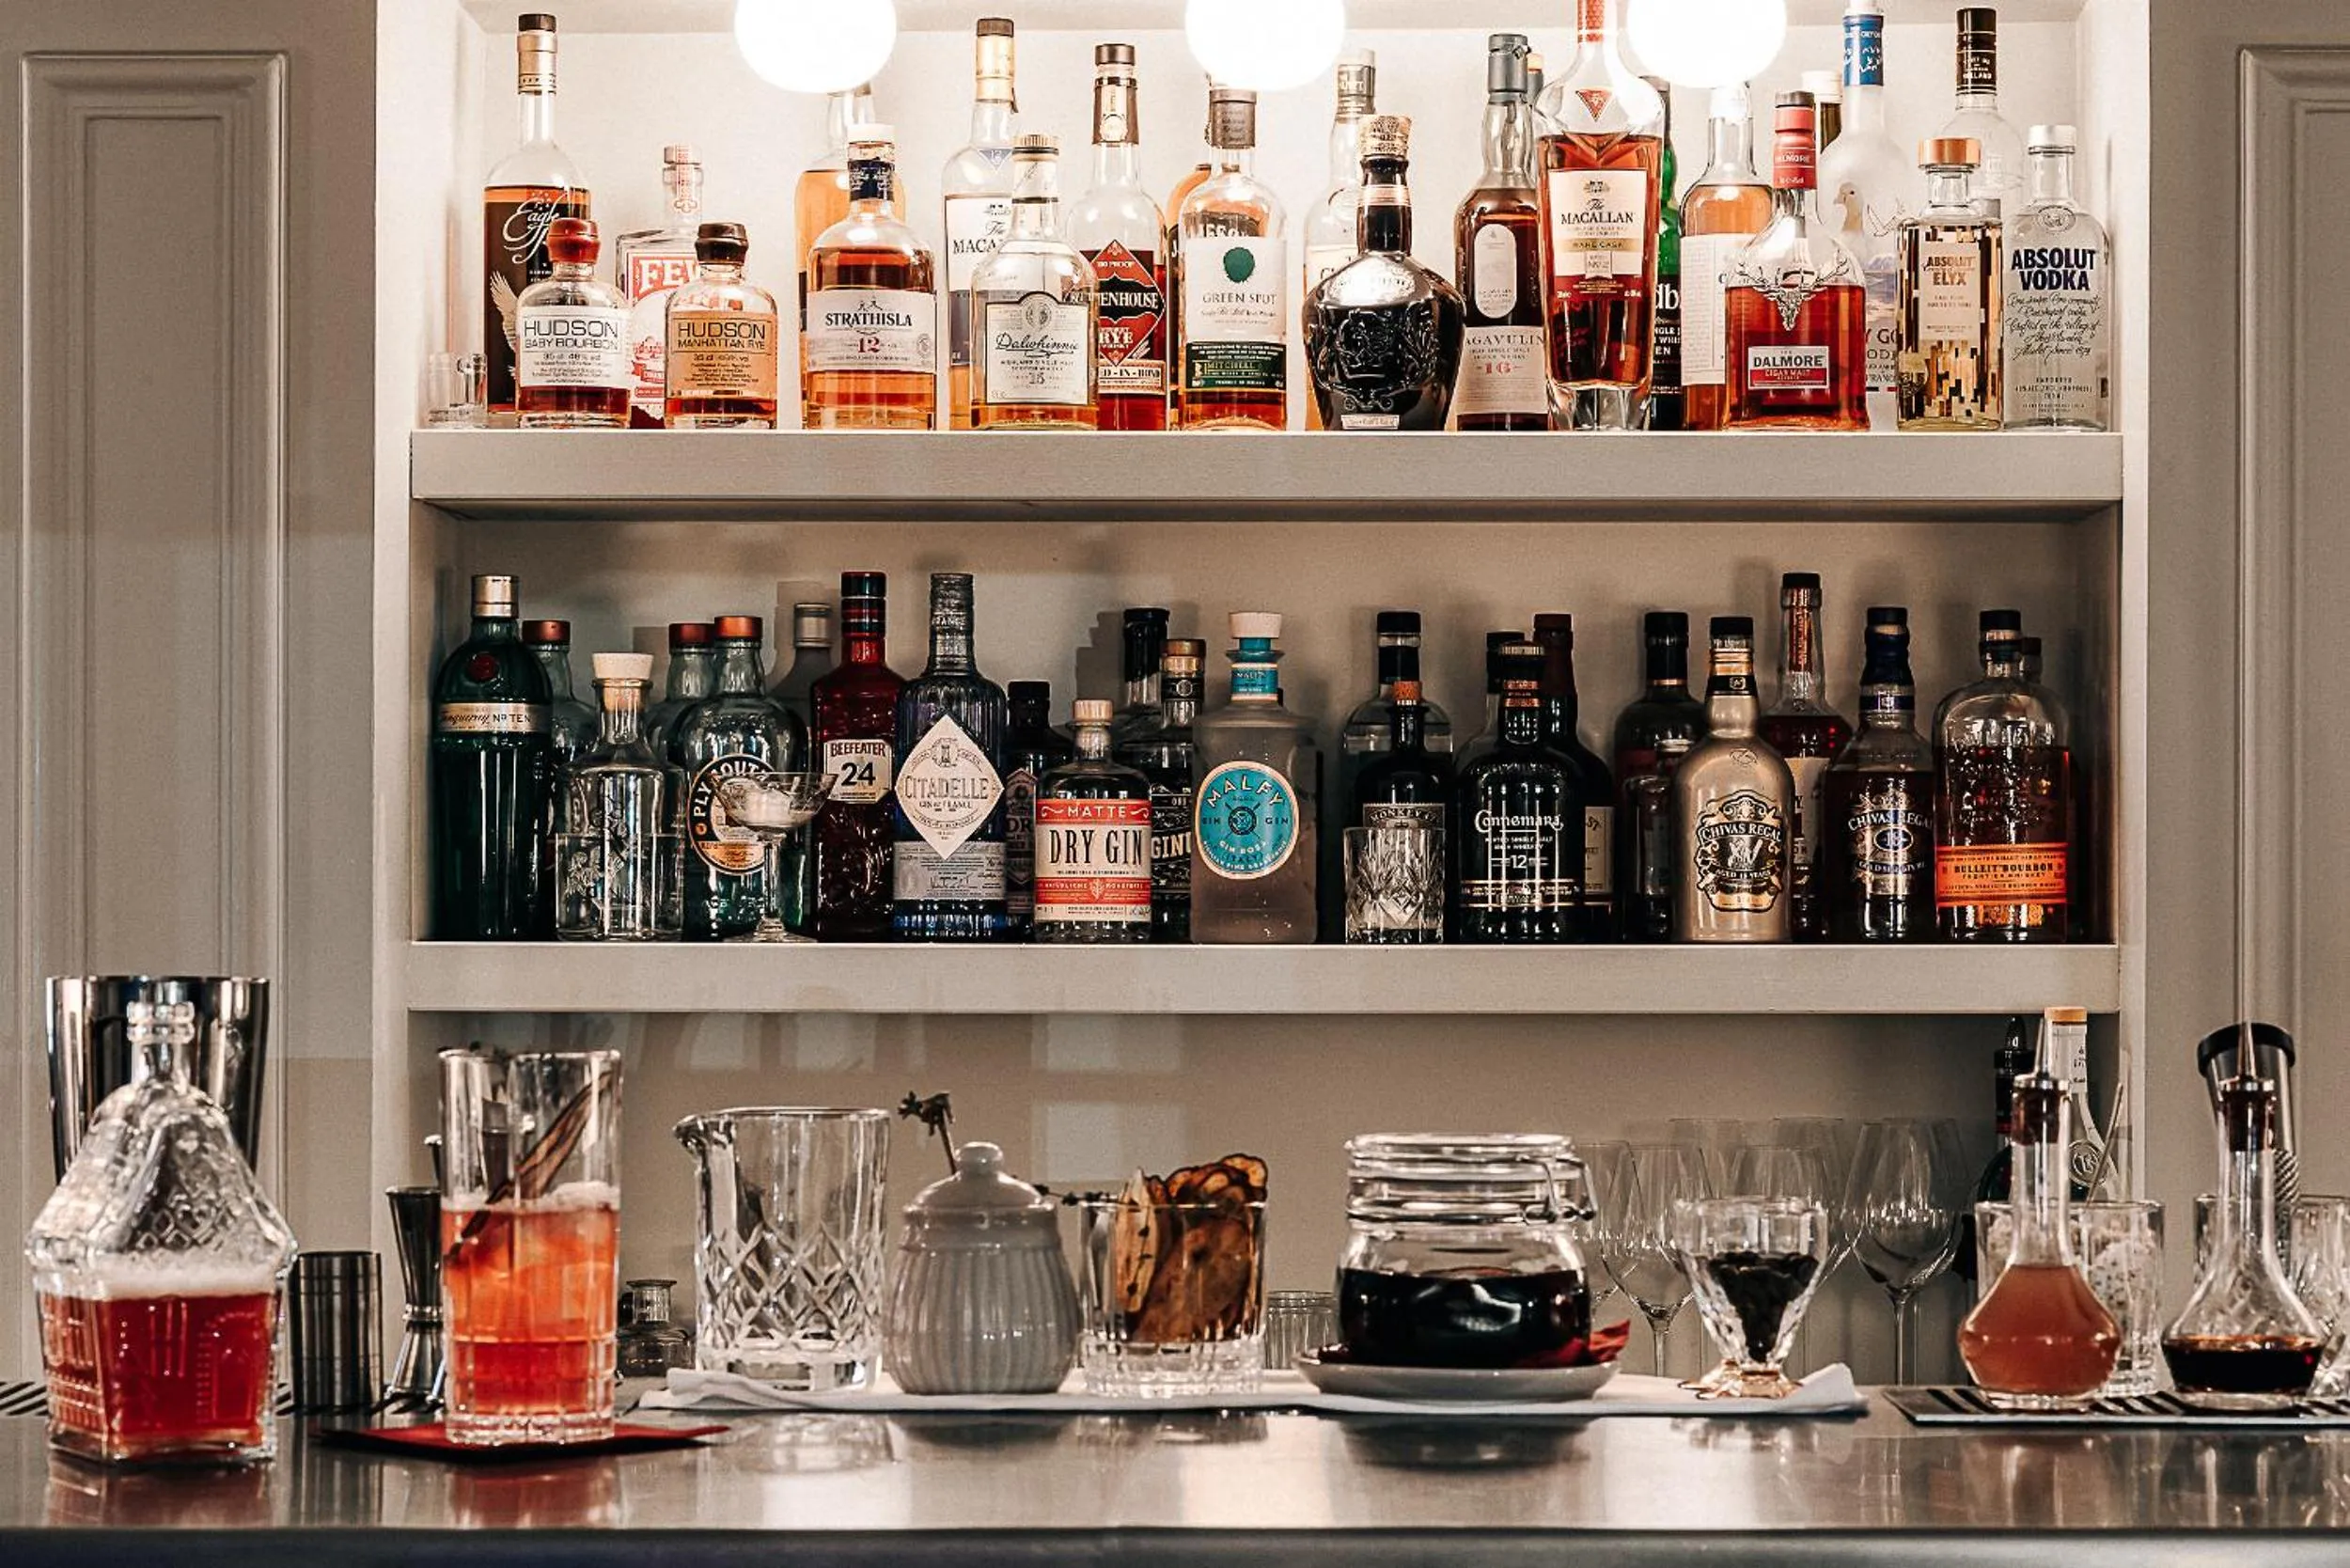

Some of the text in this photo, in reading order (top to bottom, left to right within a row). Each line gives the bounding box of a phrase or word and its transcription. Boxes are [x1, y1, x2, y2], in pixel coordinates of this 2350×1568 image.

[1560, 212, 1635, 225] MACALLAN
[1927, 256, 1976, 267] ABSOLUT
[2011, 247, 2096, 270] ABSOLUT
[1933, 272, 1967, 286] ELYX
[2019, 269, 2091, 291] VODKA
[1203, 292, 1277, 305] GREEN SPOT
[824, 312, 913, 327] STRATHISLA
[524, 320, 619, 337] HUDSON
[678, 321, 766, 339] HUDSON
[525, 337, 619, 350] BABY BOURBON
[678, 338, 766, 351] MANHATTAN RYE
[857, 336, 881, 353] 12
[1099, 331, 1134, 344] RYE
[1754, 355, 1824, 368] DALMORE
[509, 714, 531, 723] TEN
[830, 742, 886, 758] BEEFEATER
[840, 761, 877, 787] 24
[904, 775, 990, 800] CITADELLE
[1206, 775, 1286, 808] MALFY
[1067, 806, 1127, 818] MATTE
[1264, 817, 1289, 825] GIN
[1475, 809, 1564, 833] Connemara
[1847, 811, 1893, 832] CHIVAS
[1702, 823, 1782, 842] CHIVAS REGAL
[1049, 829, 1143, 866] DRY GIN
[1510, 855, 1528, 869] 12
[1954, 863, 2054, 873] BULLEIT BOURBON
